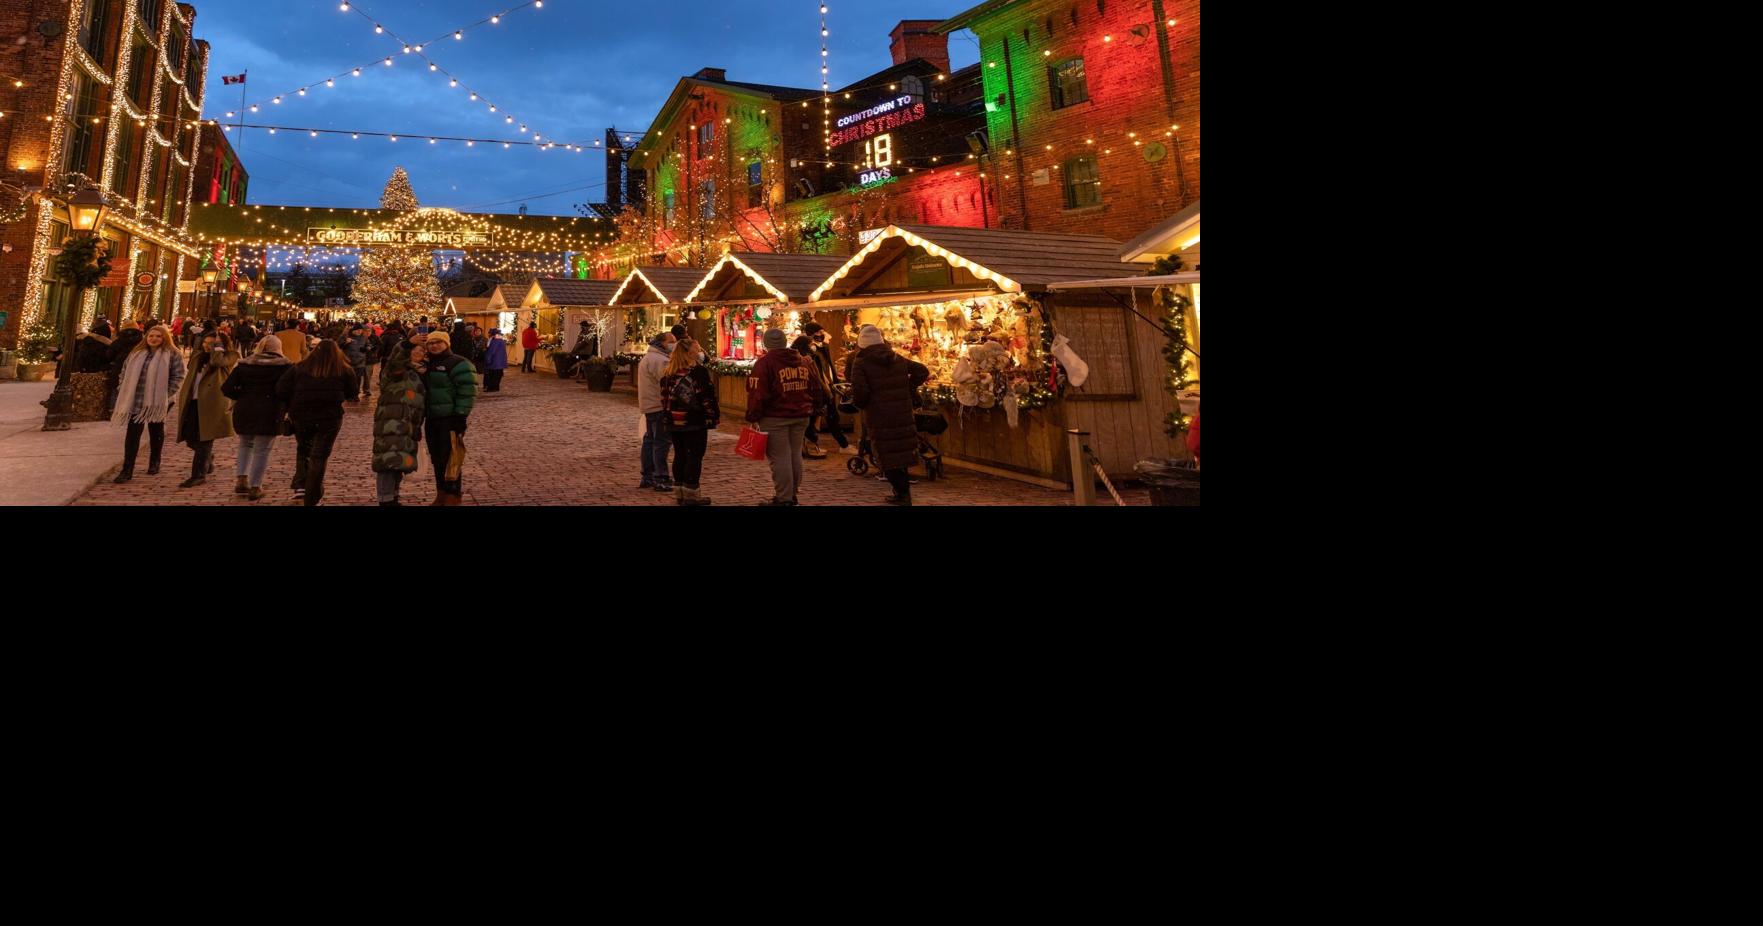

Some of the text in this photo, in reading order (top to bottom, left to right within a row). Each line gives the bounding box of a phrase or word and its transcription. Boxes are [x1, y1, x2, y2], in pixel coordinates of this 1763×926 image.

[837, 95, 911, 127] COUNTDOWN TO
[829, 103, 925, 147] CHRISTMAS
[865, 133, 892, 169] 18
[860, 167, 891, 184] DAYS
[405, 232, 415, 242] &
[416, 232, 461, 243] WORTS
[779, 366, 809, 383] POWER
